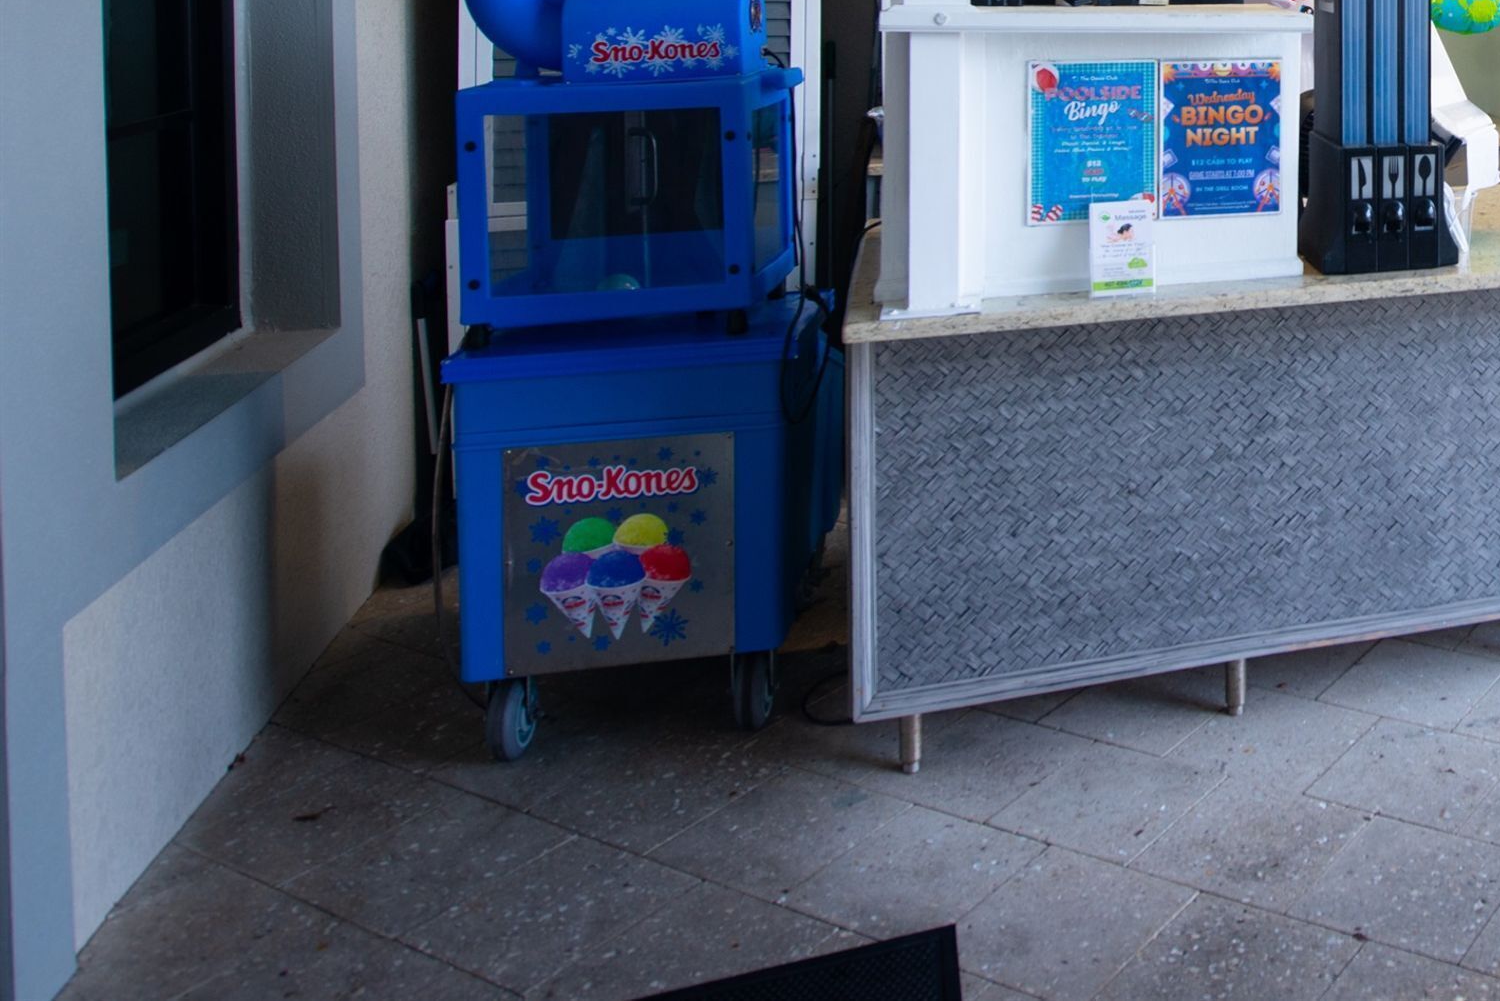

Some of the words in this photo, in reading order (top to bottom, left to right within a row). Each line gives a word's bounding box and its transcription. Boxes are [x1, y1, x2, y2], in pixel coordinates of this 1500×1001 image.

[592, 39, 721, 63] Sno-Kones
[1044, 85, 1142, 102] POOLSIDE
[1187, 88, 1255, 105] Wednesday
[1064, 100, 1120, 126] Bingo
[1181, 104, 1264, 126] BINGO
[1186, 126, 1259, 148] NIGHT
[1238, 157, 1253, 165] PLAY
[527, 466, 698, 504] Sno-Kones
